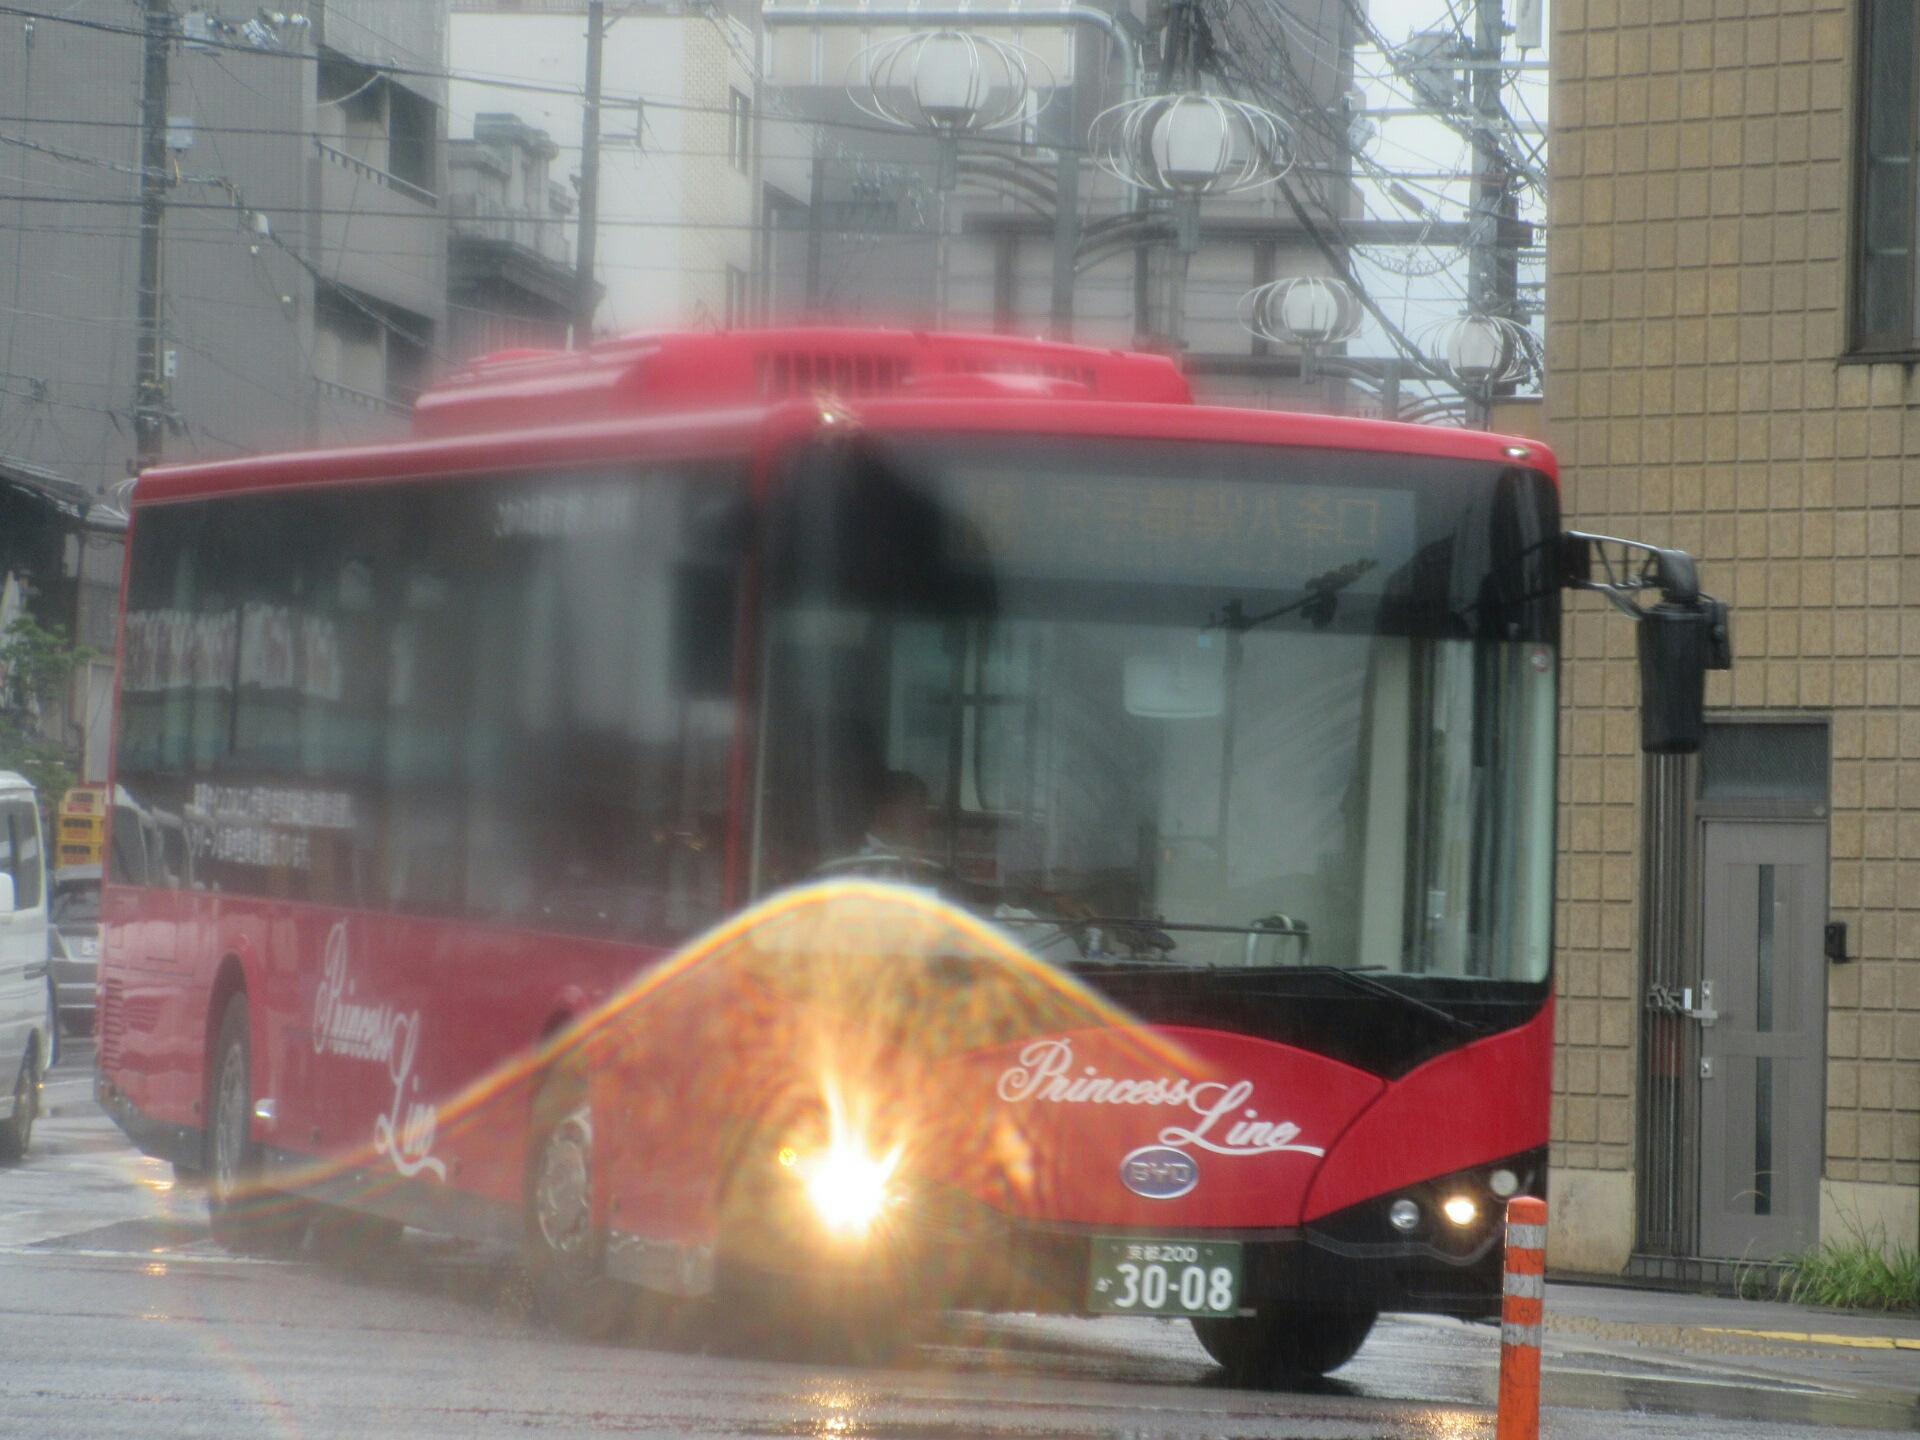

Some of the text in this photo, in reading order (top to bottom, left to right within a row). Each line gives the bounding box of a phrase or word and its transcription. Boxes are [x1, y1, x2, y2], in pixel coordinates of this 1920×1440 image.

[313, 916, 446, 1182] Princess Line
[998, 1038, 1326, 1157] Princess Line
[1130, 1161, 1191, 1183] BYD
[1114, 1263, 1233, 1312] 30-08
